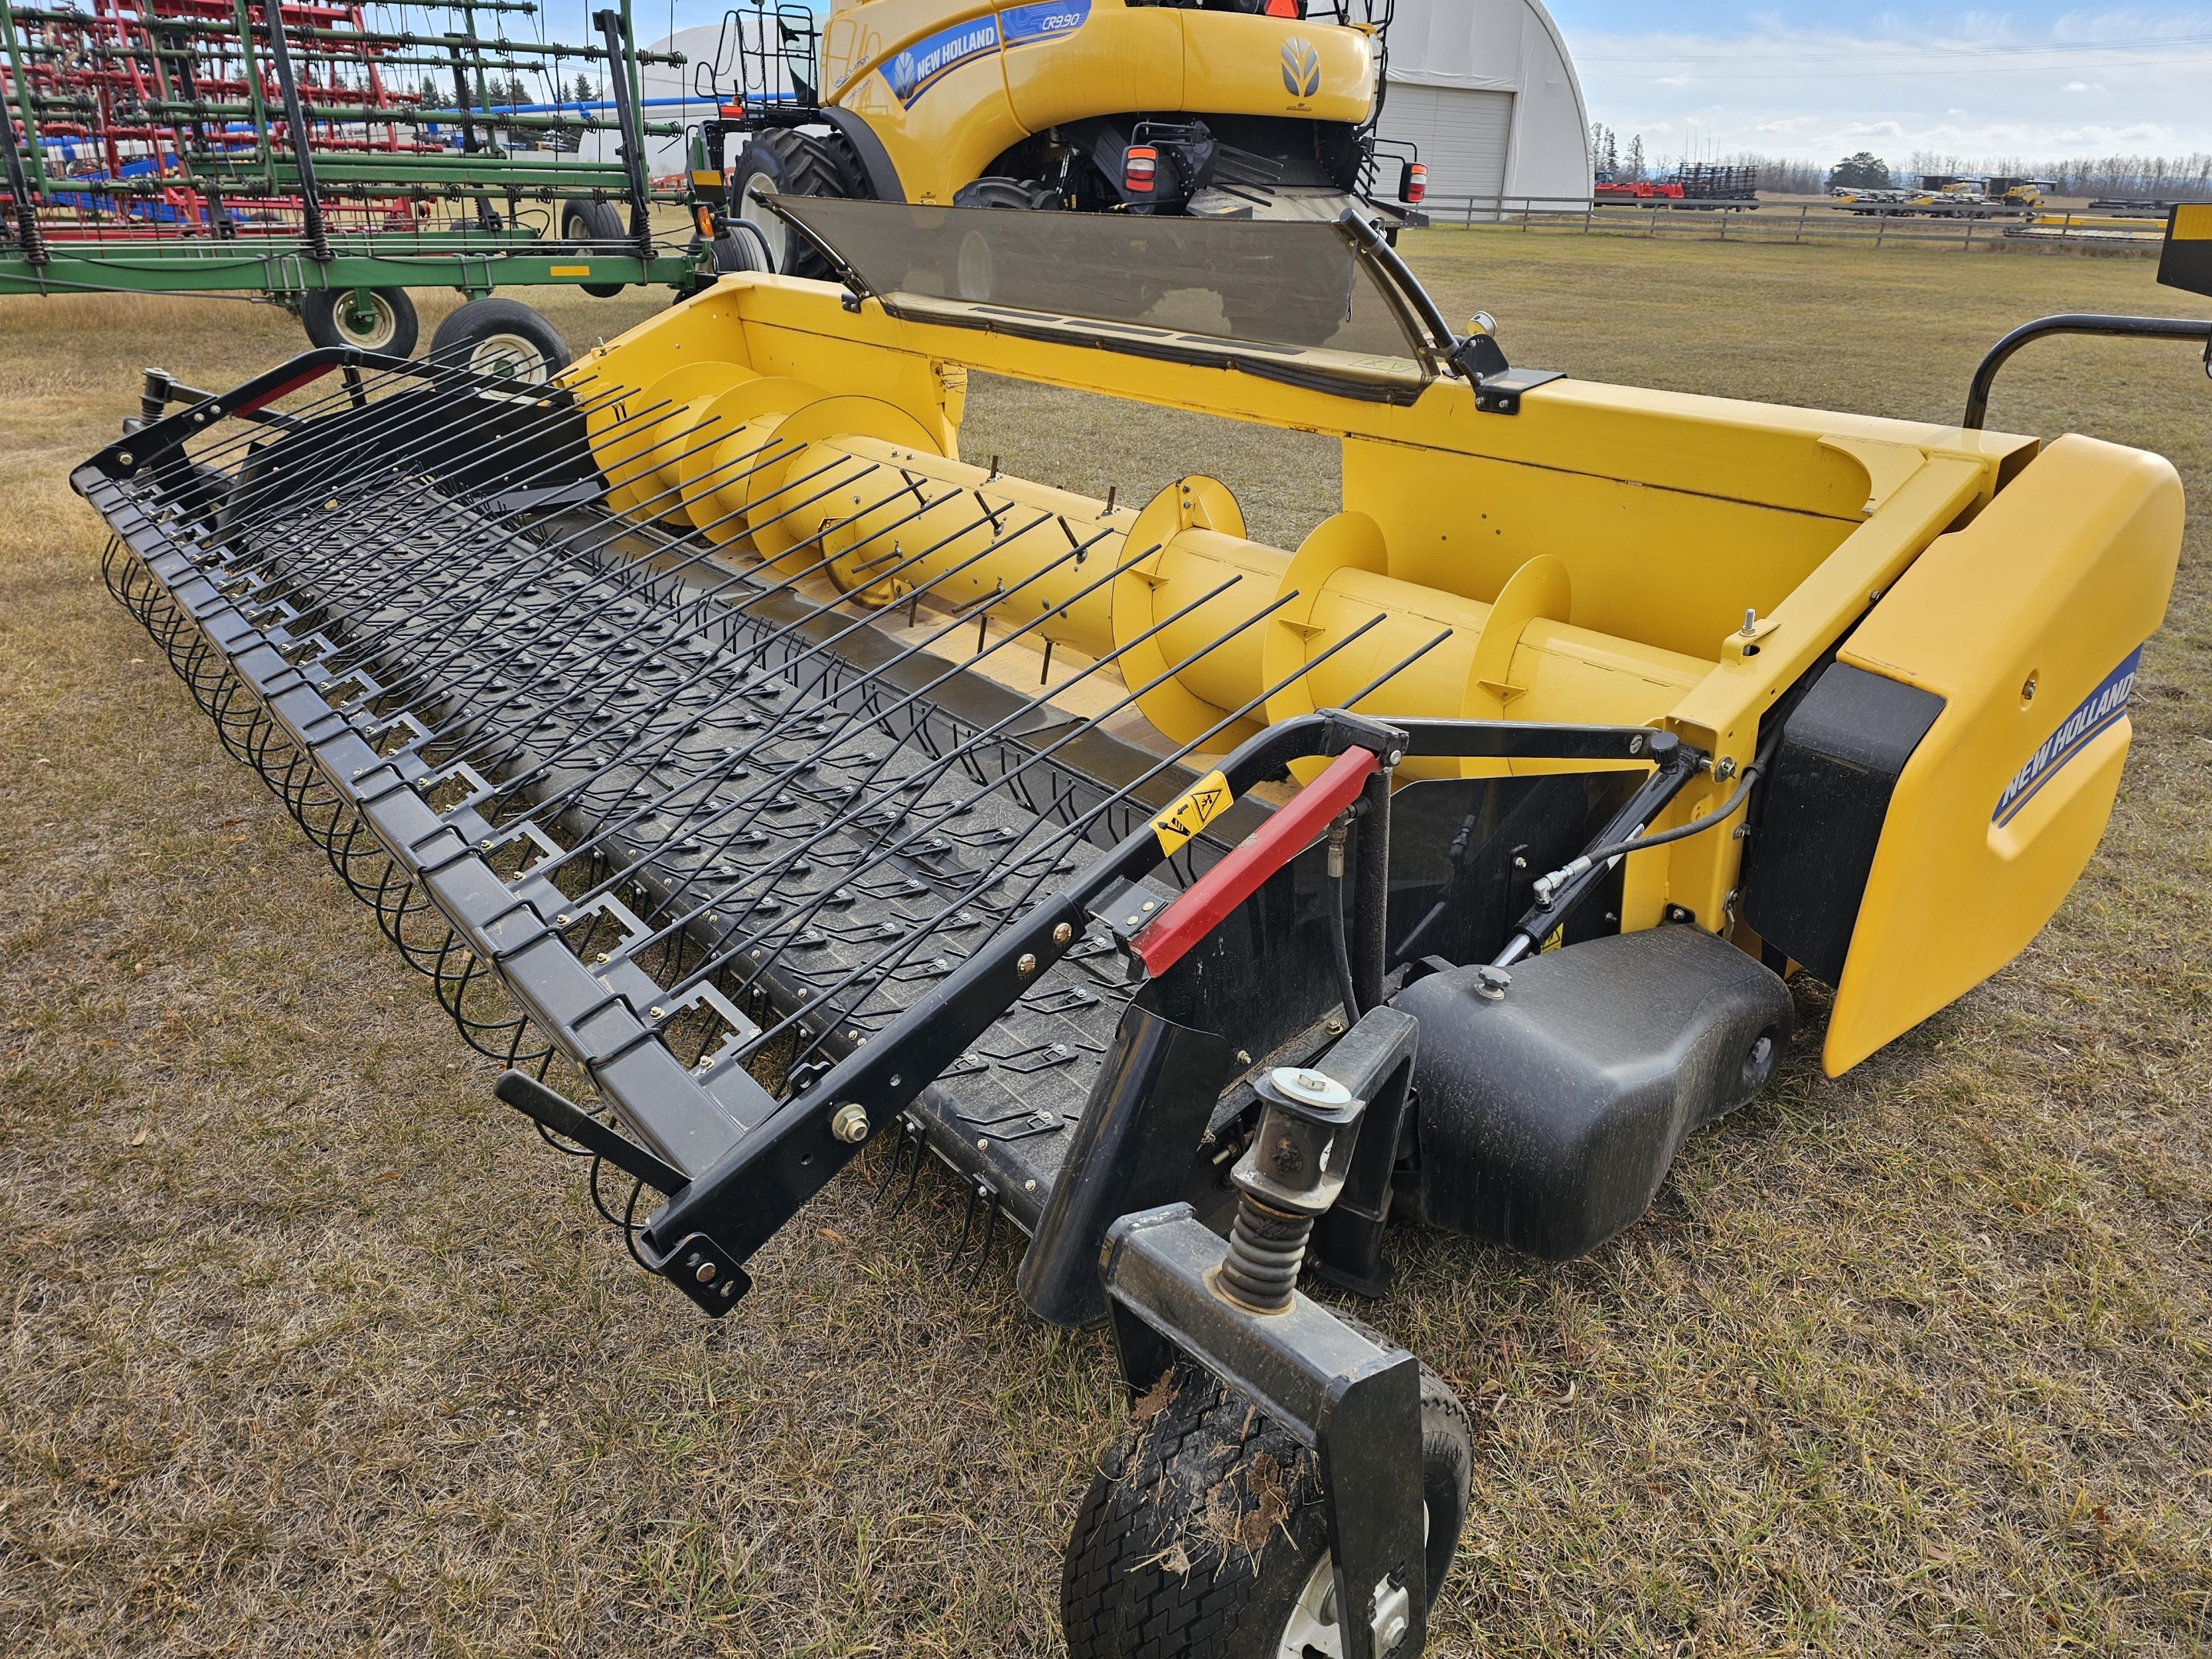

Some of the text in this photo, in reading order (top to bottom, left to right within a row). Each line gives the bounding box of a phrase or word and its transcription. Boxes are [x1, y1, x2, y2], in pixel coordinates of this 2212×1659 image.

[1042, 13, 1080, 30] CR9.90
[917, 26, 995, 81] NEW HOLLAND
[2002, 671, 2135, 808] NEW HOLLAND
